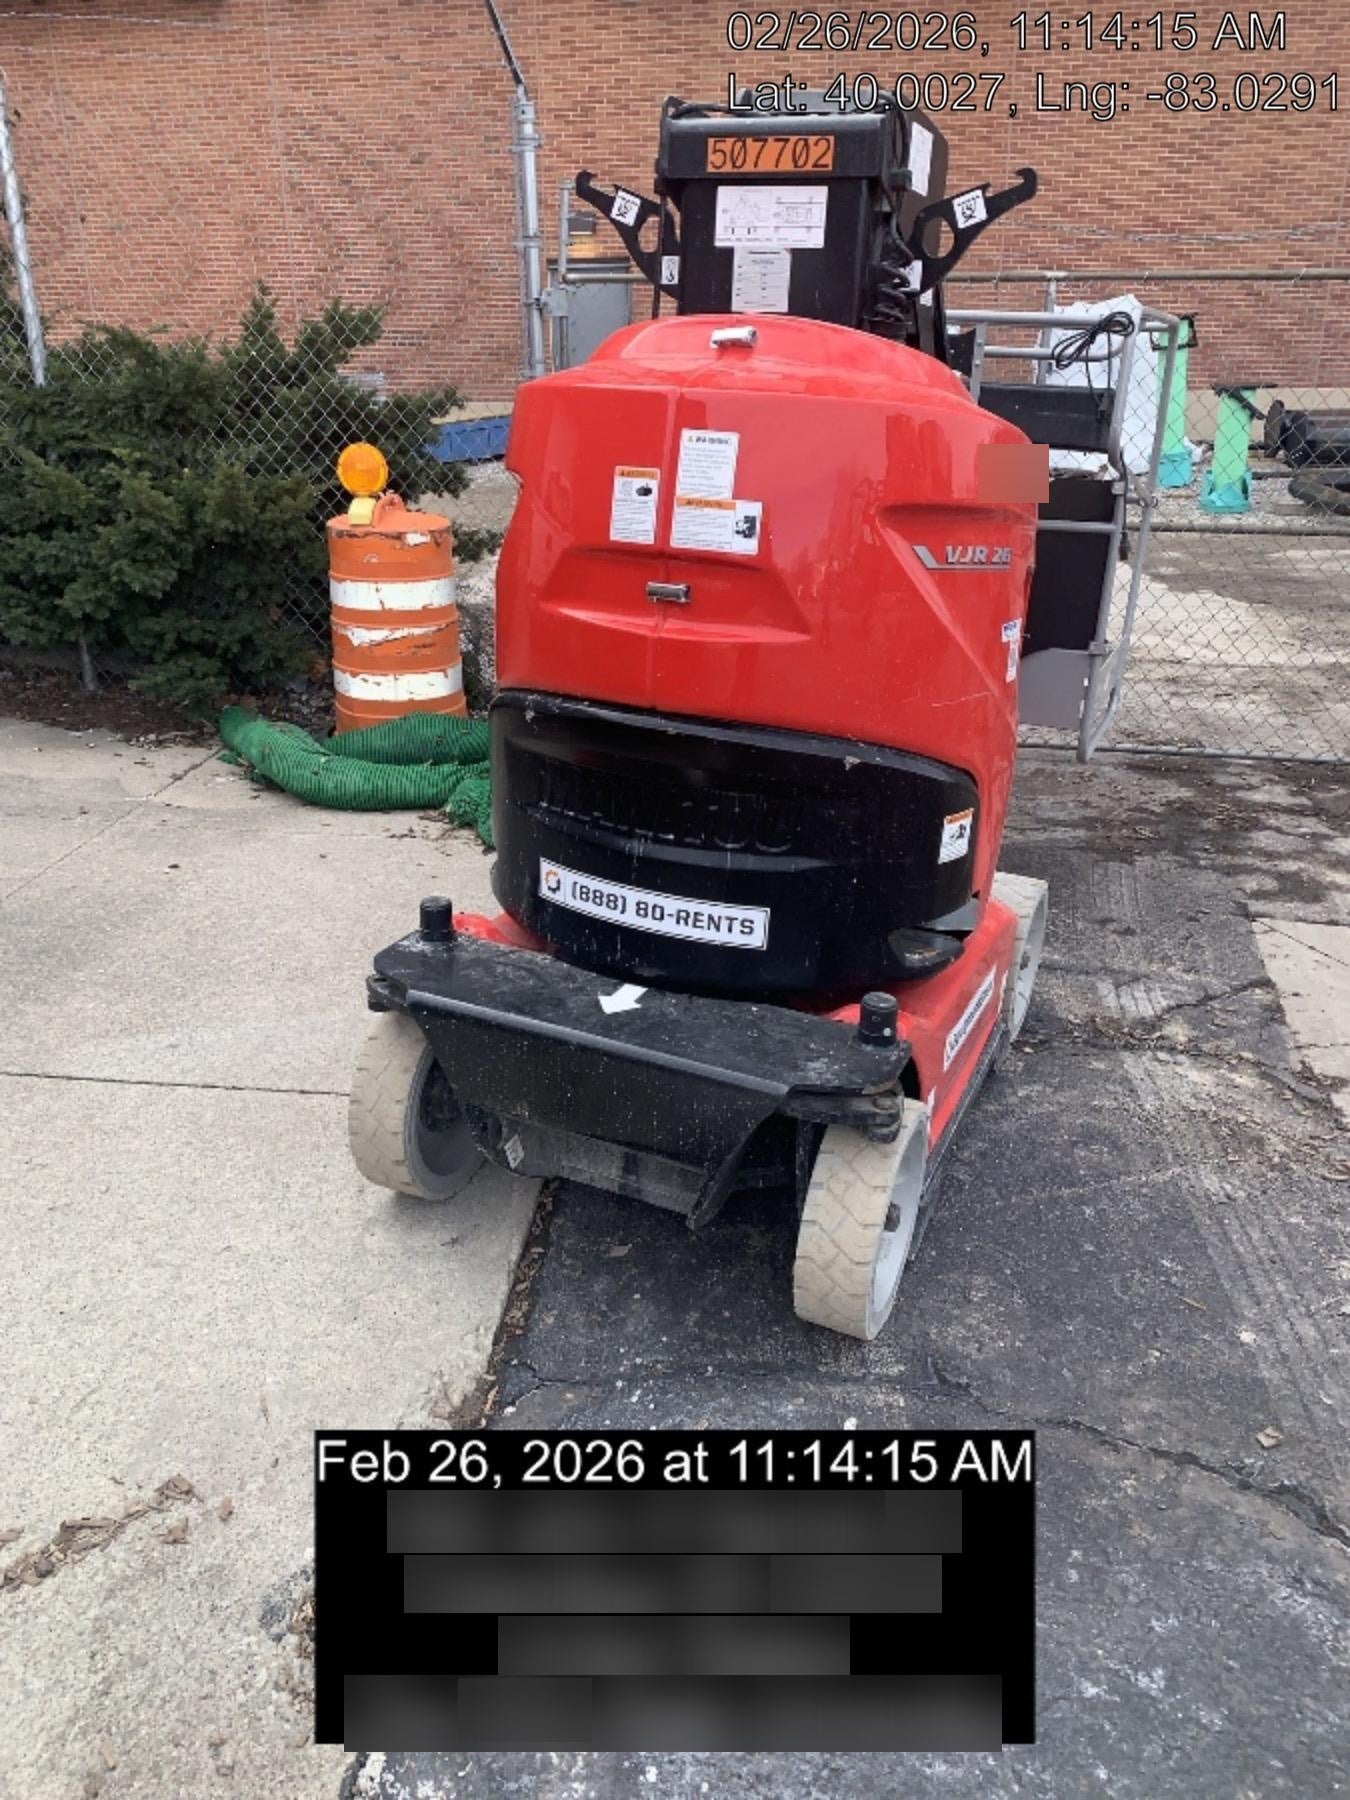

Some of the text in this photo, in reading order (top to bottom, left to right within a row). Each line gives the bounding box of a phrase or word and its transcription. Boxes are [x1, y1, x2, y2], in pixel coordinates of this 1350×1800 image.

[709, 137, 832, 170] 507702
[944, 545, 989, 564] VJR
[571, 881, 755, 936] (888) 80-RENTS
